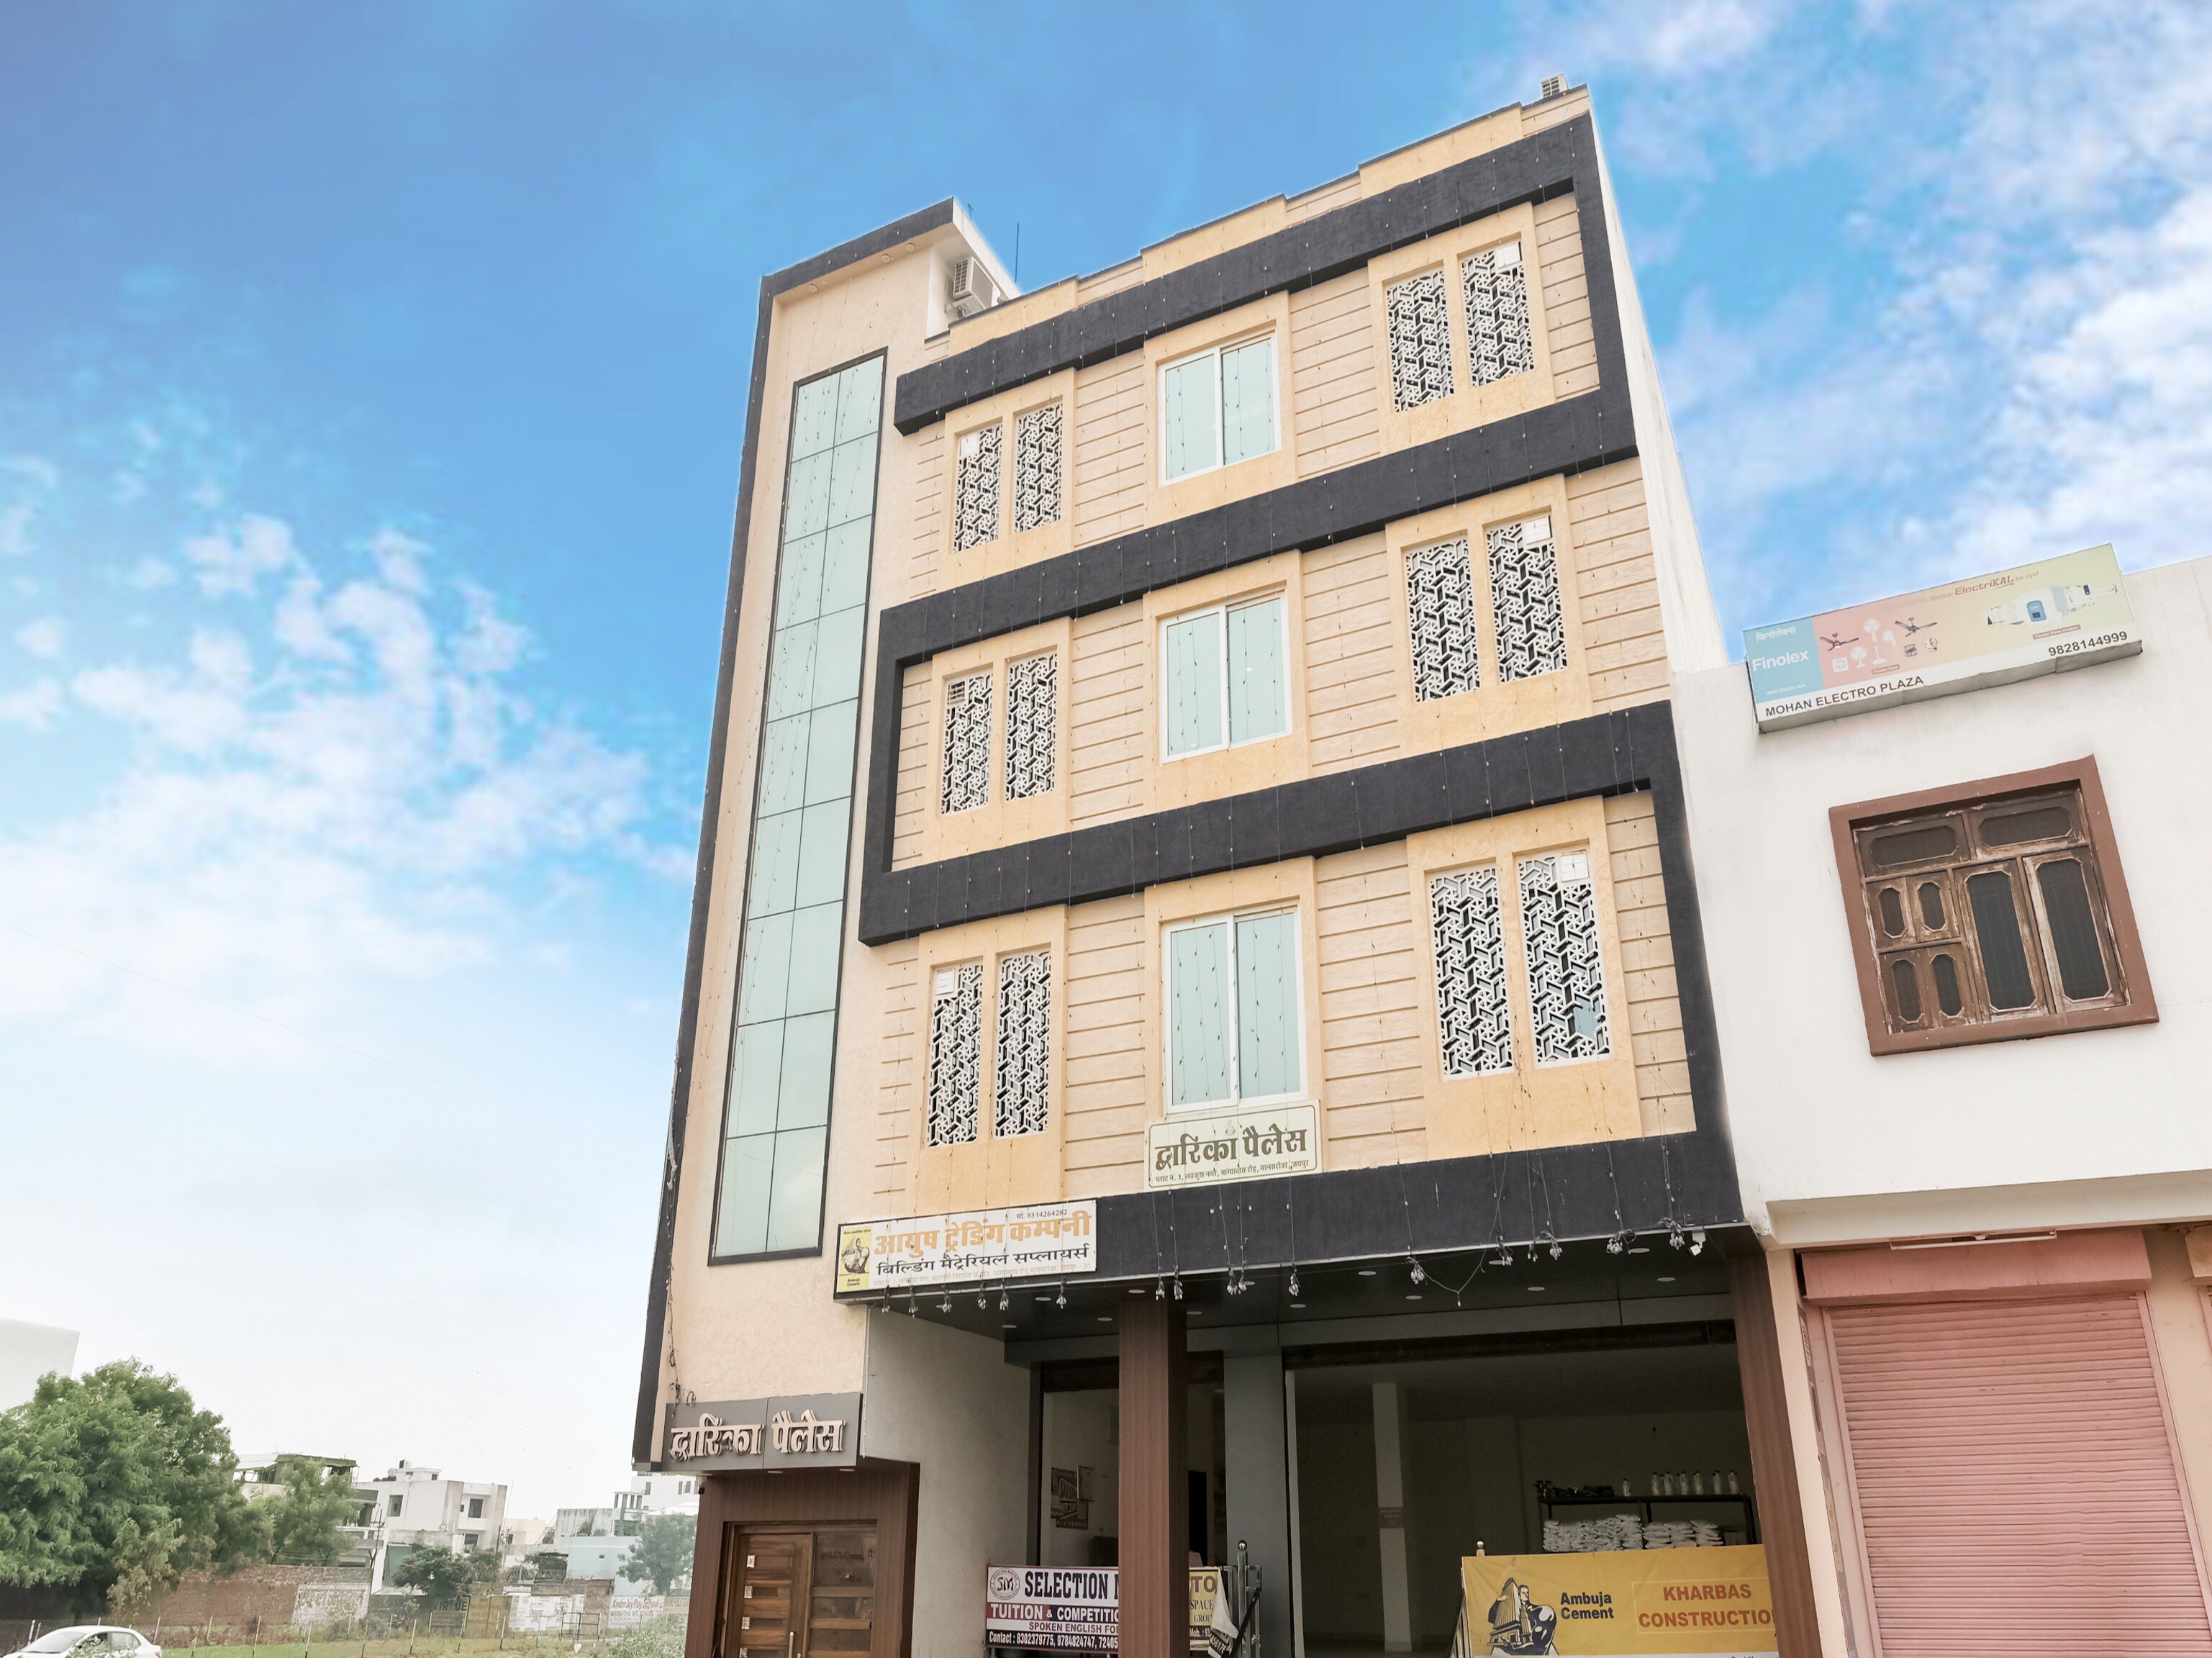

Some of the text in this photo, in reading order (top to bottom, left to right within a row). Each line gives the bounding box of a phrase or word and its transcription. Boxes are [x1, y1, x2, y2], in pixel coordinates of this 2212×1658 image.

[1955, 575, 2014, 596] ElectriKAL
[2048, 630, 2128, 656] 9828144999
[1751, 650, 1809, 671] Finolex
[1765, 675, 1924, 717] MOHAN ELECTRO PLAZA
[1154, 1123, 1307, 1171] द्वारिका पैलेस
[1027, 1209, 1067, 1219] 9314264282
[874, 1210, 1092, 1258] आयुष ट्रेडिंग कम्पनी
[876, 1258, 935, 1275] बिल्डिंग
[1013, 1243, 1090, 1264] सप्लायर्स
[771, 1409, 846, 1454] पैलेस
[1025, 1571, 1108, 1600] SELECTION
[1191, 1575, 1216, 1593] TO
[1663, 1583, 1752, 1601] KHARBAS
[1190, 1600, 1213, 1611] SPACE
[1560, 1591, 1612, 1608] Ambuja
[990, 1603, 1043, 1620] TUITION
[1046, 1609, 1053, 1618] &
[1561, 1606, 1615, 1620] Cement
[1638, 1610, 1775, 1628] CONSTRUCTIO
[1029, 1621, 1118, 1634] SPOKEN ENGLISH FO
[1189, 1628, 1201, 1637] Mob.
[989, 1631, 1012, 1644] Contact
